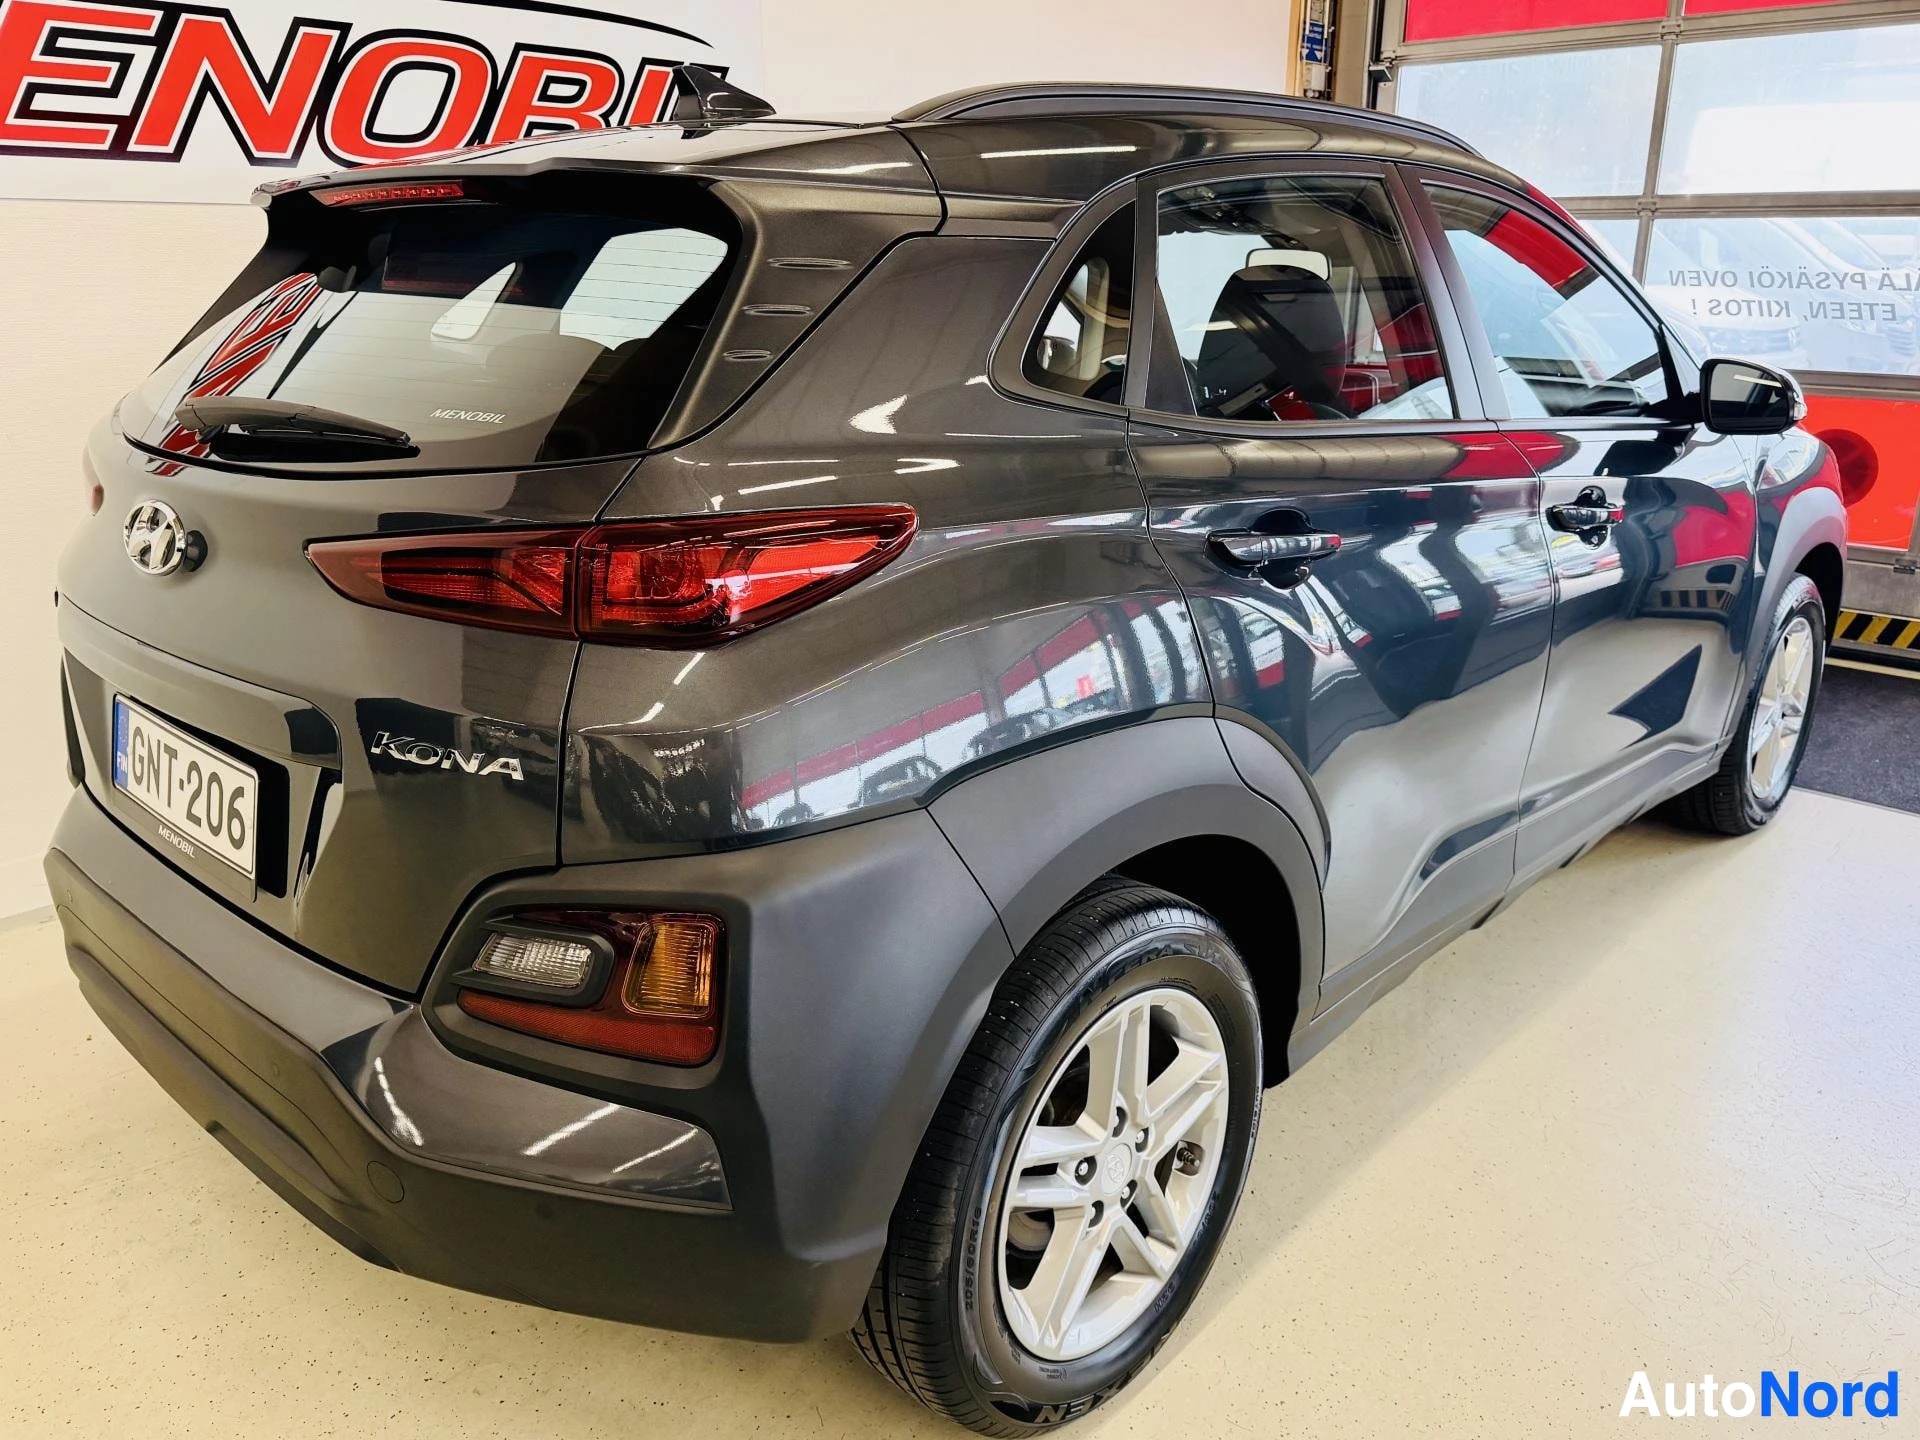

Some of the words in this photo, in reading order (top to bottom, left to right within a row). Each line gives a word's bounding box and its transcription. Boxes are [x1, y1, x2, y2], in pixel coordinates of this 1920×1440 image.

[0, 0, 729, 168] ENOBI
[430, 408, 506, 424] MENOBIL
[117, 753, 128, 774] FIN
[370, 731, 525, 781] KONA
[132, 726, 246, 850] GNT-206
[158, 825, 195, 858] MENOBIL
